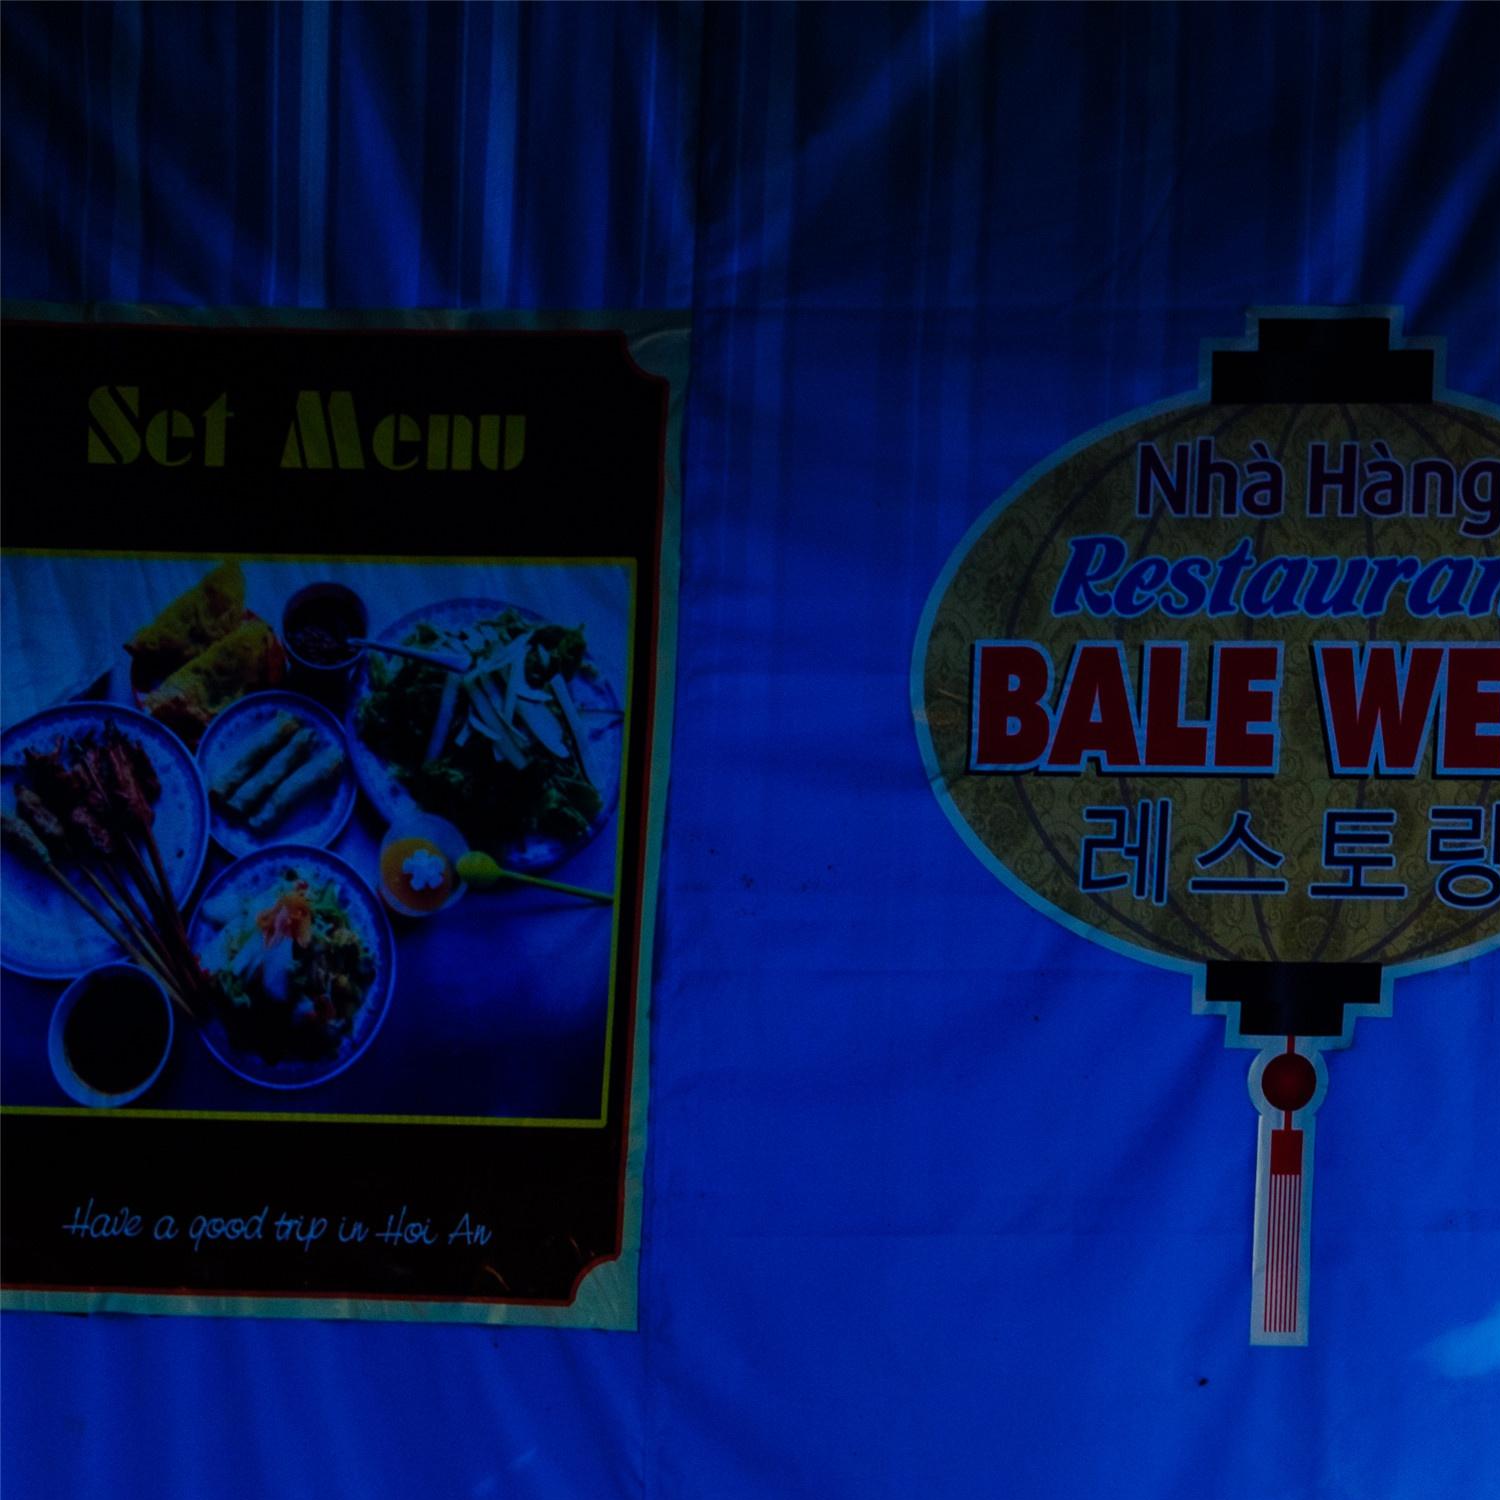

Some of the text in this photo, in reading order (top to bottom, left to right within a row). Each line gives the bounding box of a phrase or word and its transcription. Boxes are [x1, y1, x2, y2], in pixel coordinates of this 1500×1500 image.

[87, 385, 527, 471] Set Menu
[1134, 436, 1286, 520] Nhà
[966, 639, 1286, 775] BALE
[61, 1198, 494, 1252] Have a good trip in Hoi An
